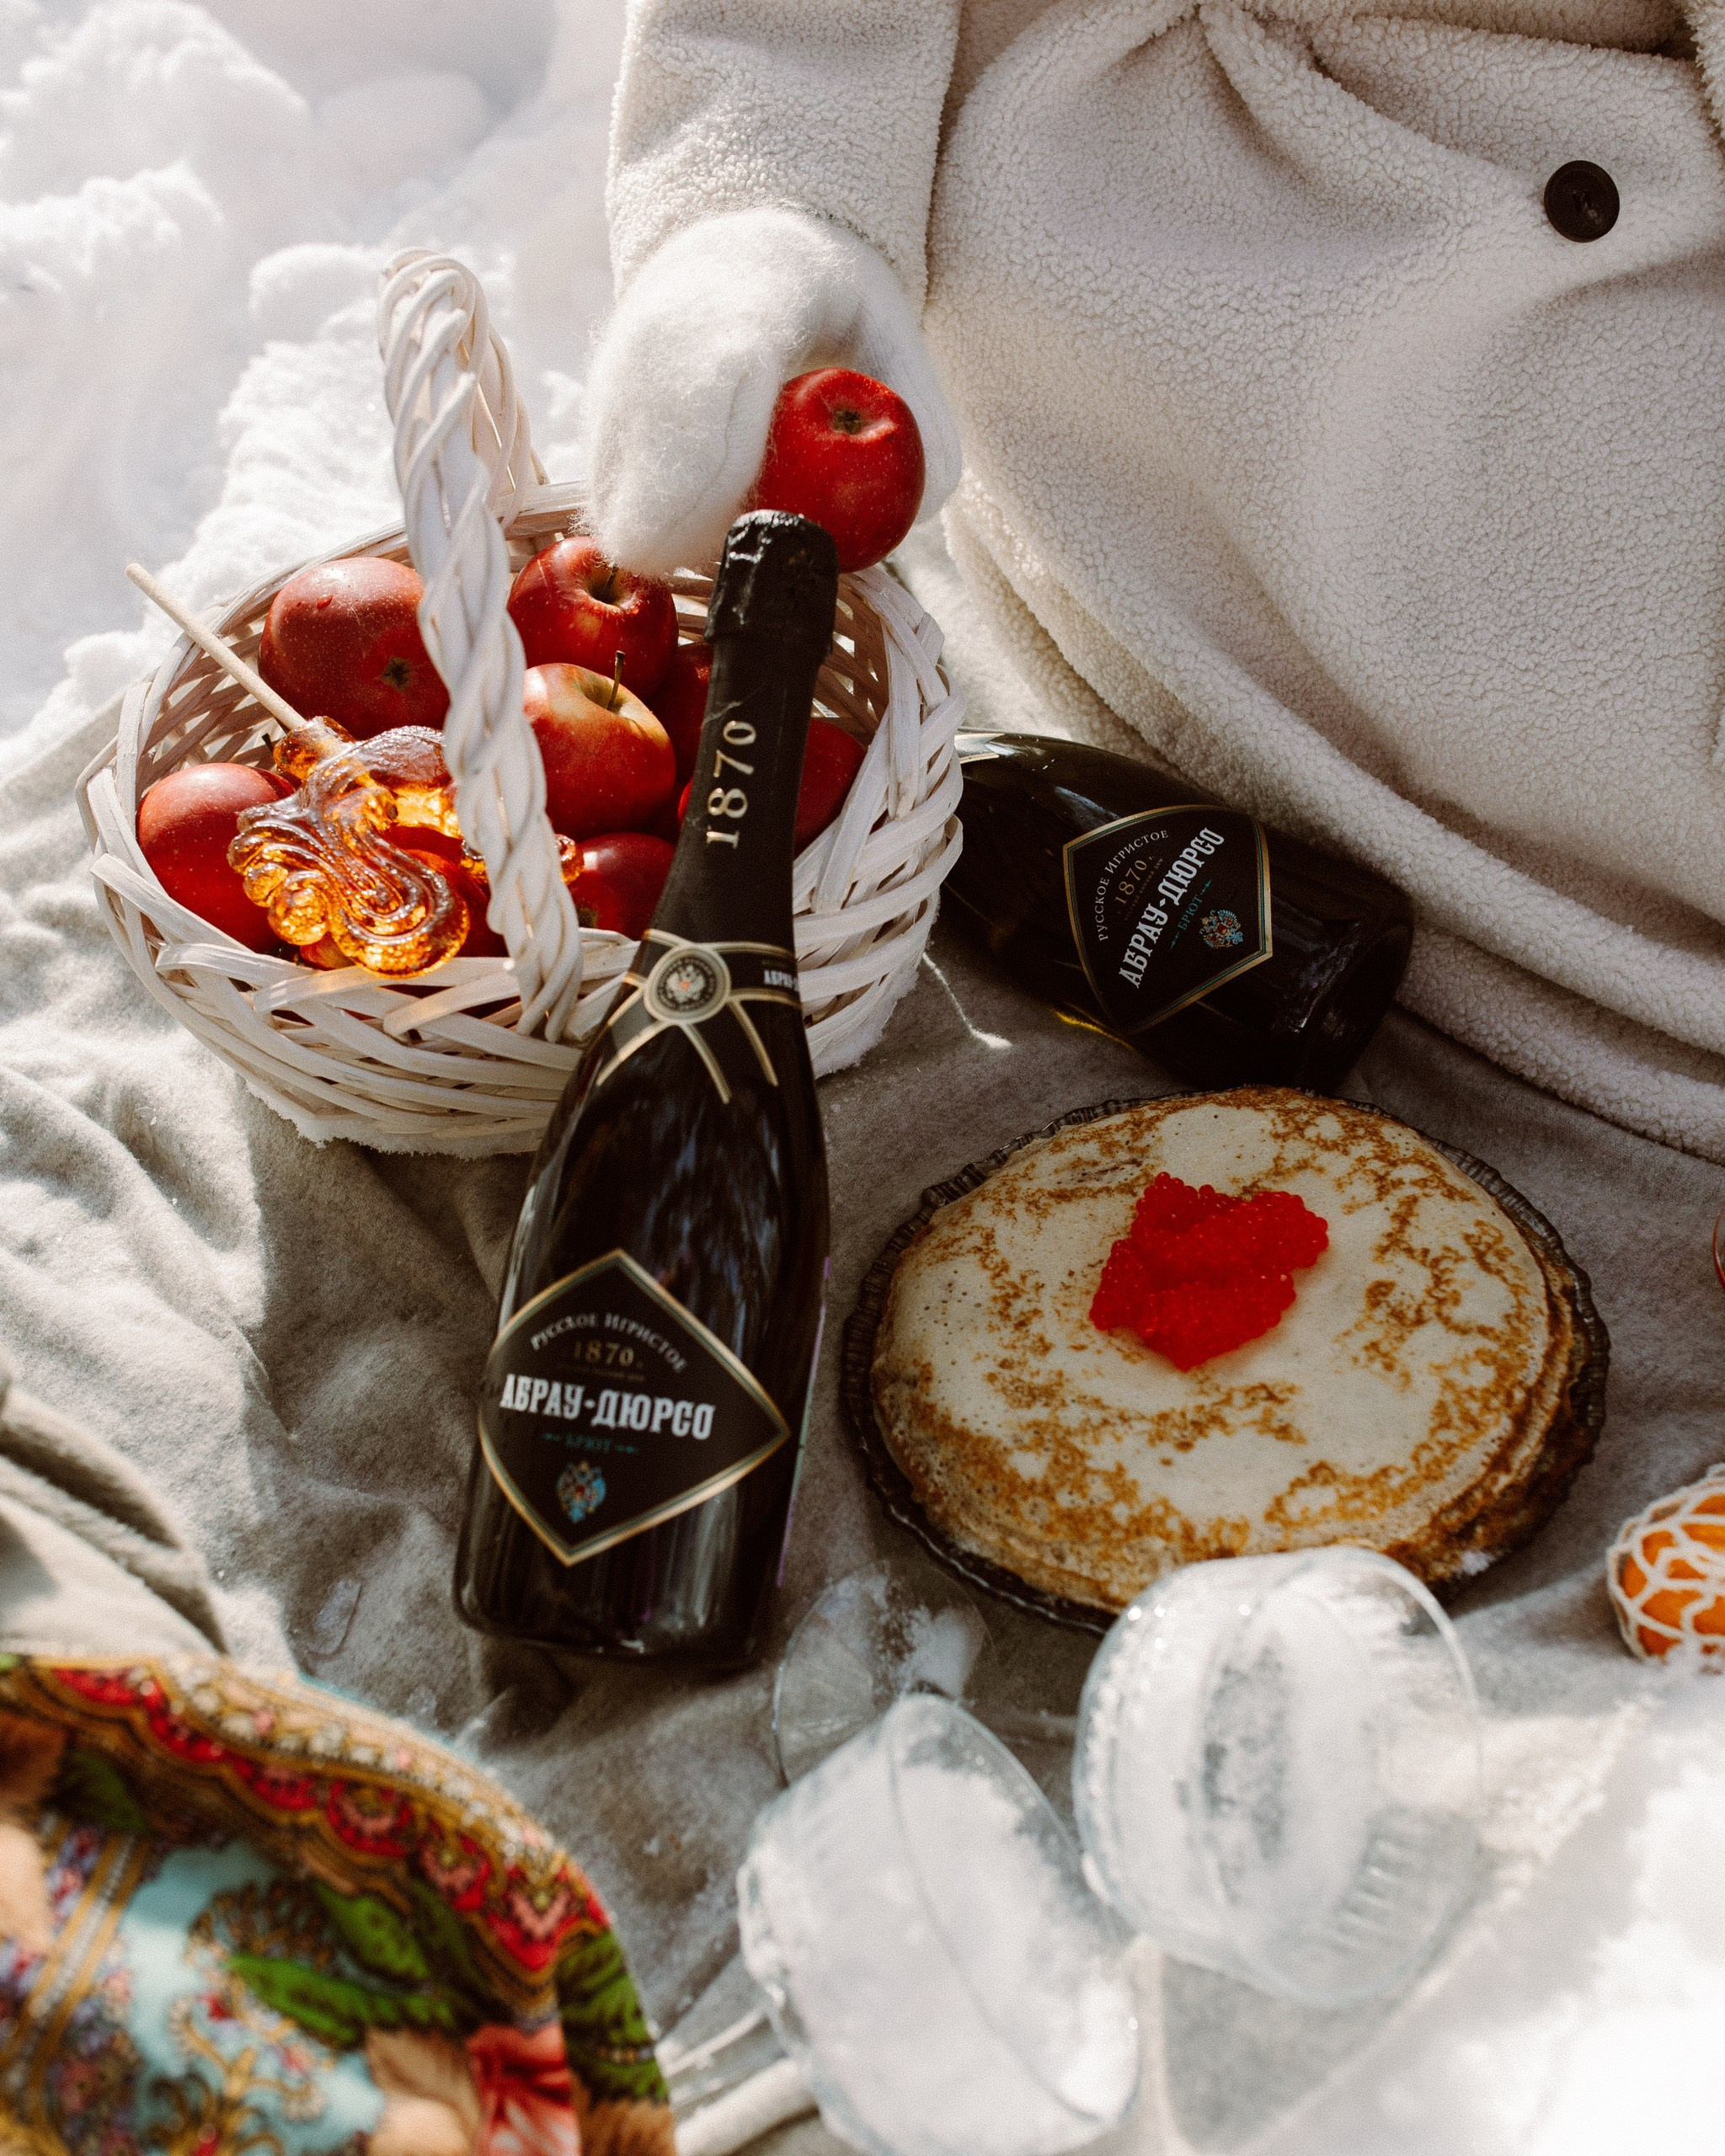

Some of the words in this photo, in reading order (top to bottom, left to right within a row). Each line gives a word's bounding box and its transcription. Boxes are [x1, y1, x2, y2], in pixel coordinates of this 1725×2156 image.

[707, 720, 756, 849] 1870
[1095, 878, 1110, 941] РУССКОЕ
[1104, 830, 1168, 873] ИГРИСТОЕ
[1115, 860, 1146, 904] 1870
[1119, 827, 1225, 989] АБРАУ-ДЮРСО
[1178, 894, 1203, 931] БРЮТ
[573, 1339, 635, 1367] 1870
[499, 1373, 716, 1440] АБРАУ-ДЮРСО
